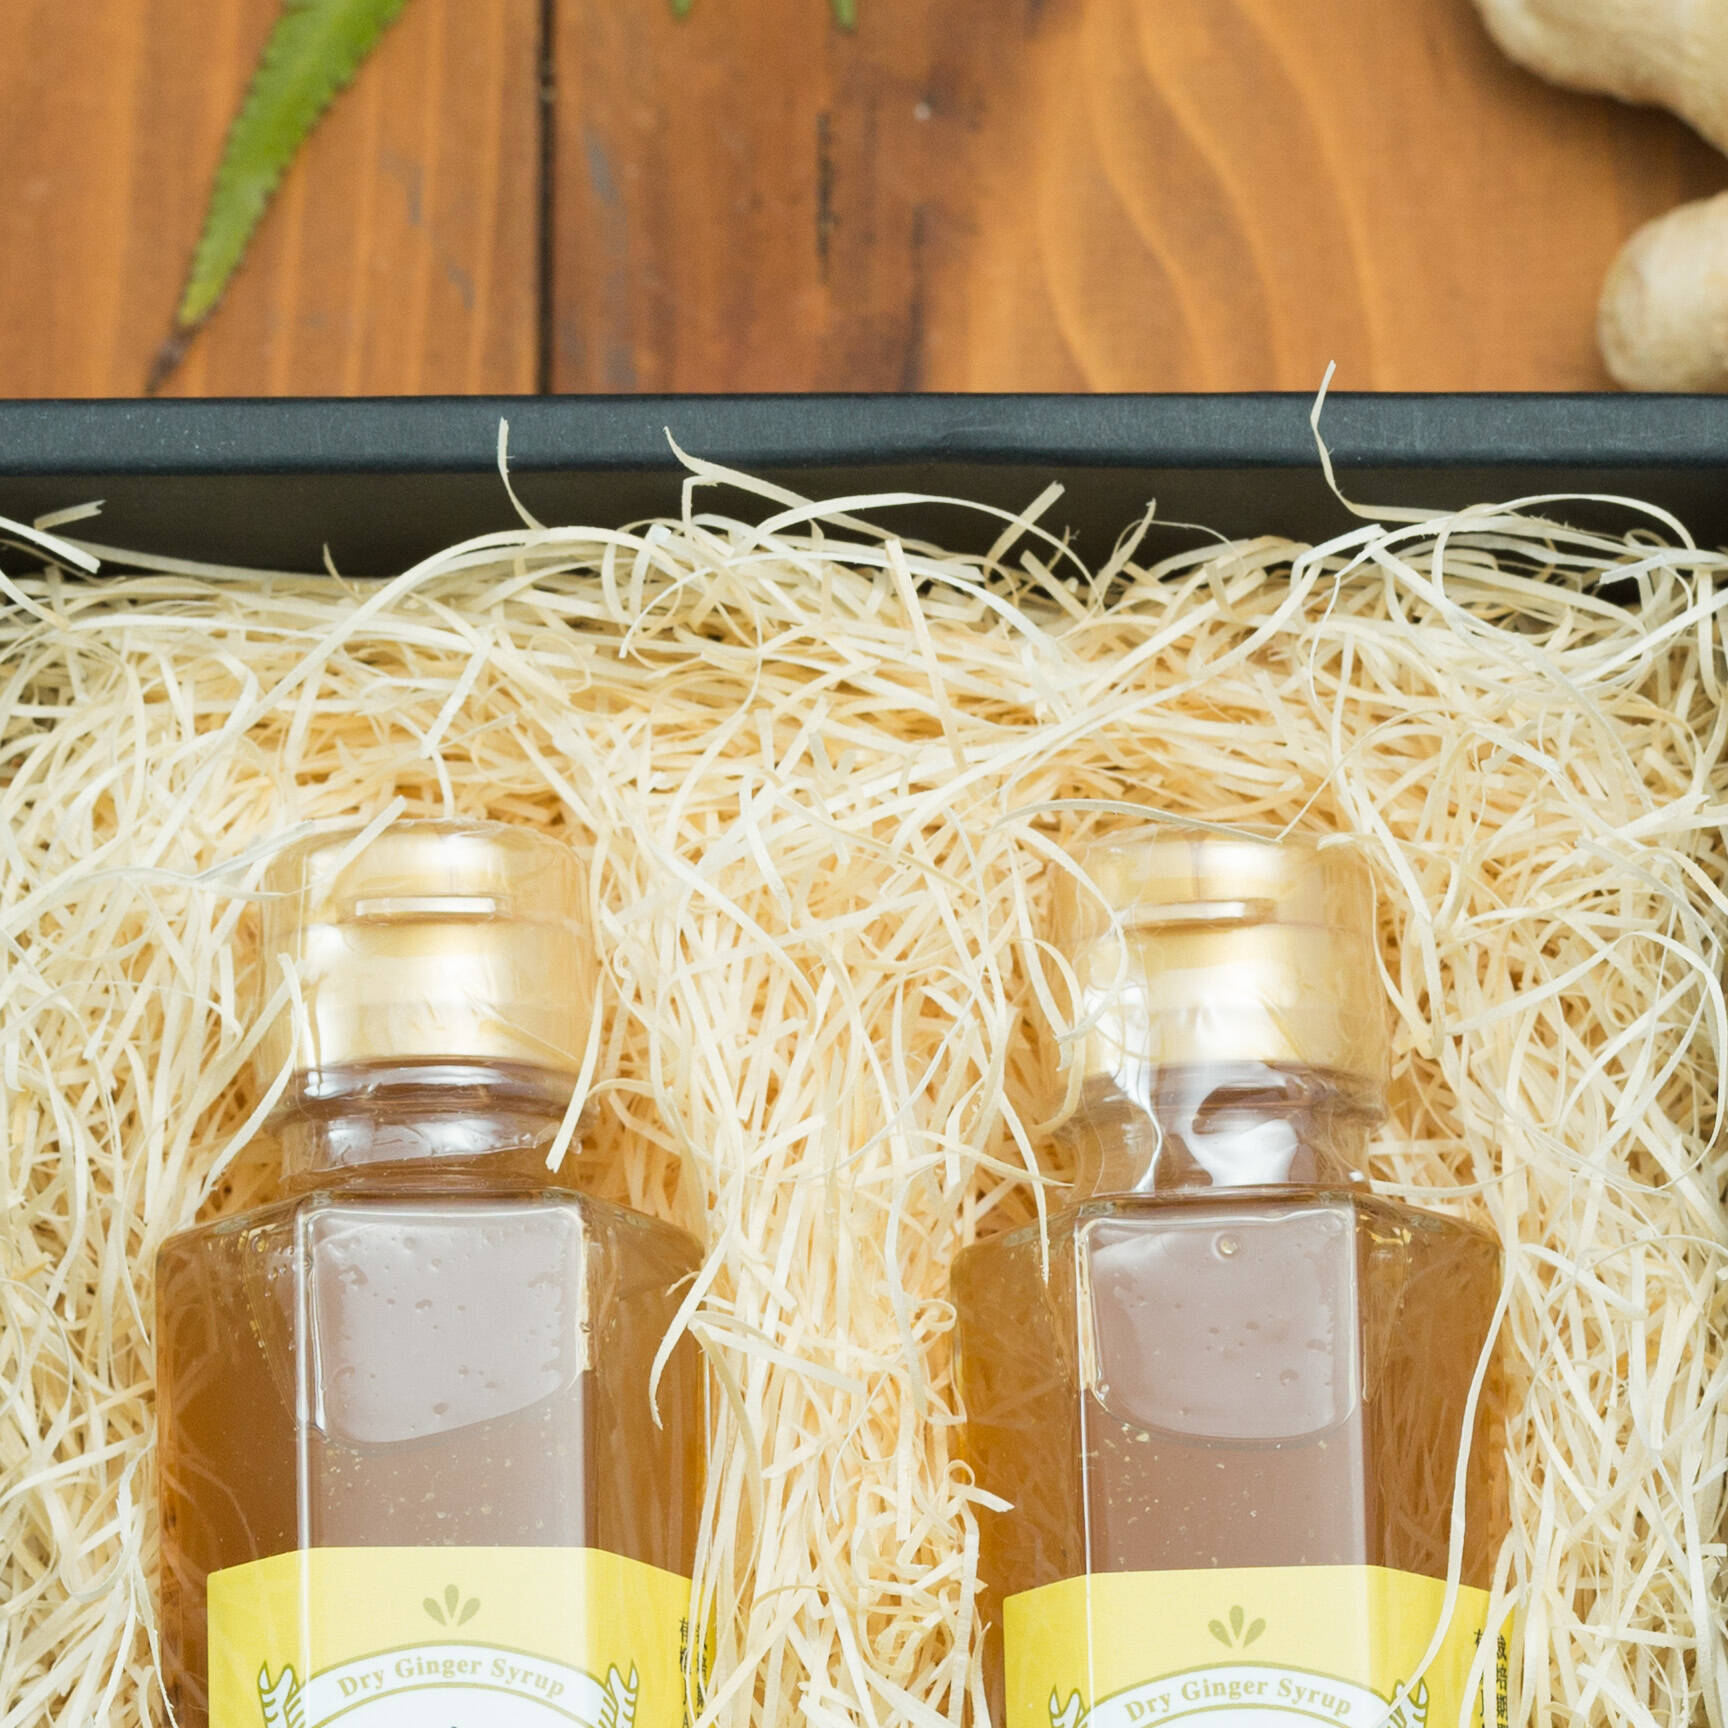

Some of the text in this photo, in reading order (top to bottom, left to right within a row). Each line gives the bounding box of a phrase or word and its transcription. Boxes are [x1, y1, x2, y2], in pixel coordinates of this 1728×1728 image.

[337, 1656, 565, 1699] Dry Ginger Syrup
[1125, 1679, 1352, 1722] Dry Ginger Syrup
